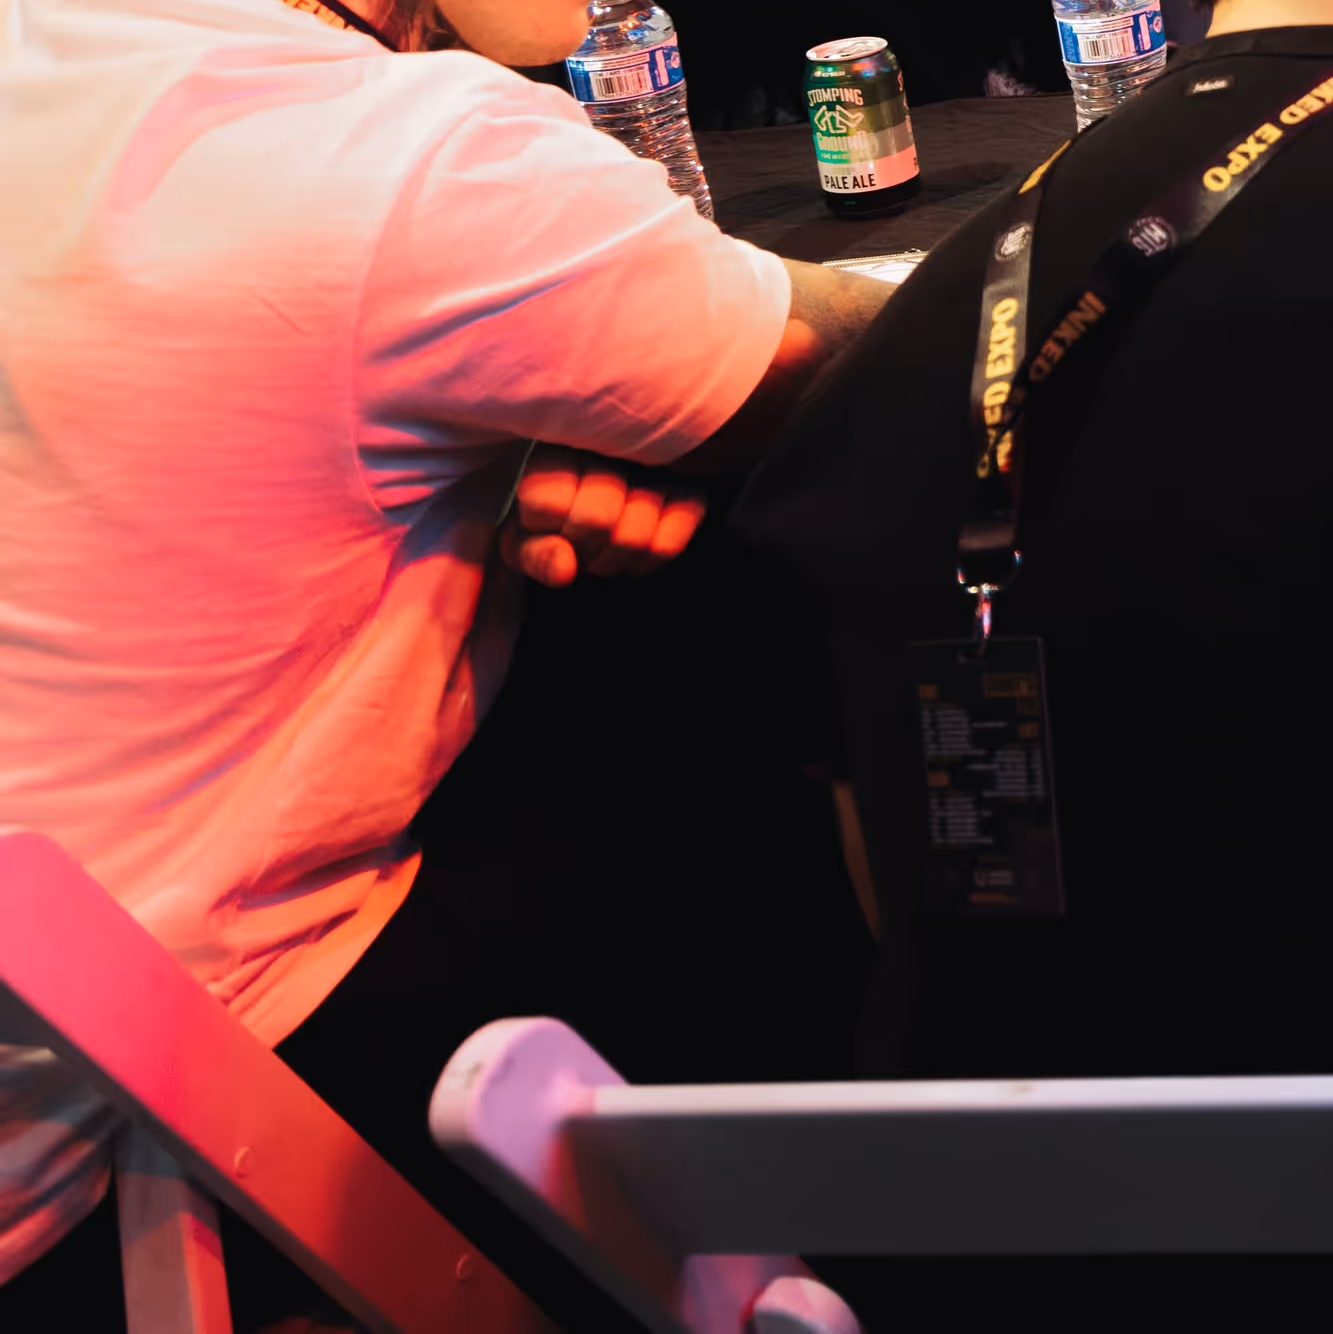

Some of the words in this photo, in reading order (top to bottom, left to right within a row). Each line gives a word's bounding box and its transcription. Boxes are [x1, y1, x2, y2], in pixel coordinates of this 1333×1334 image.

[806, 87, 864, 107] STOMPING
[1202, 121, 1284, 193] EXPO
[823, 174, 849, 191] PALE
[852, 173, 877, 190] ALE
[985, 296, 1020, 380] EXPO
